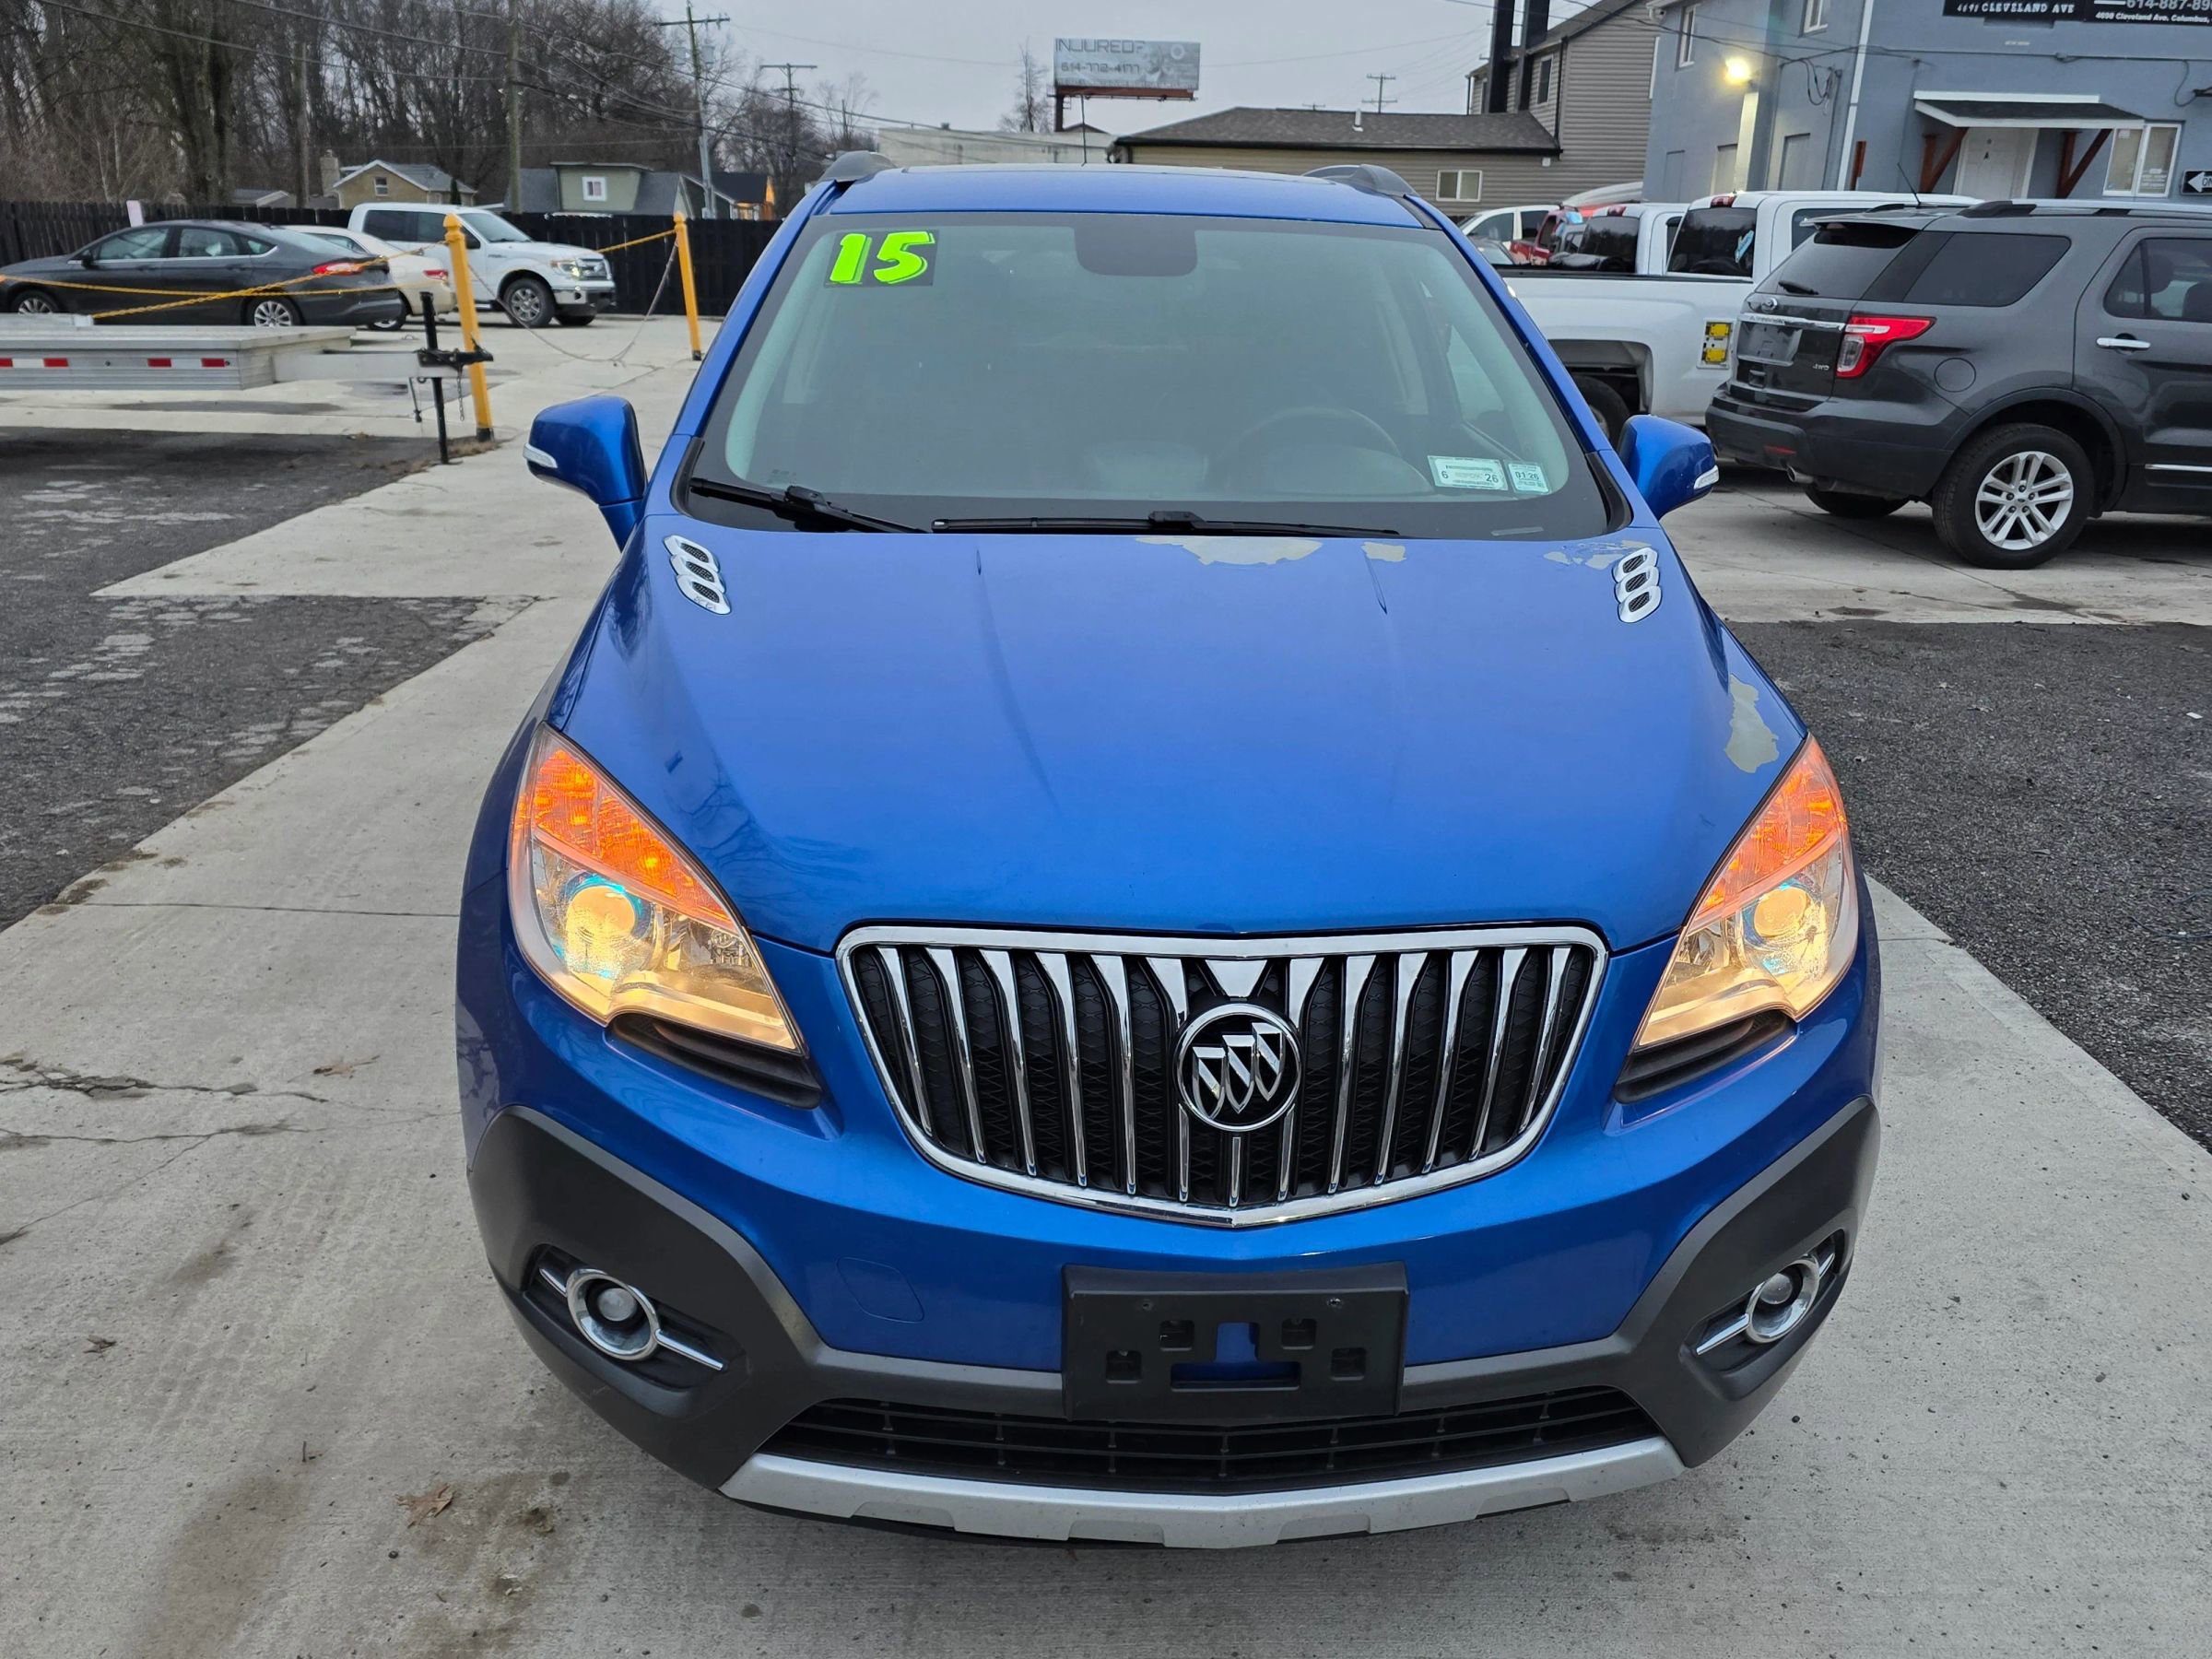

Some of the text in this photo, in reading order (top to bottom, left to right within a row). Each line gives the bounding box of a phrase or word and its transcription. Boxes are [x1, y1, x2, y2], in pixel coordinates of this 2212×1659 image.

[1982, 3, 2048, 13] CLEVELAND
[2052, 4, 2075, 13] AVE
[2126, 0, 2212, 10] 614-887-89
[830, 231, 935, 284] 15
[1441, 471, 1449, 479] 6
[1484, 473, 1499, 483] 26
